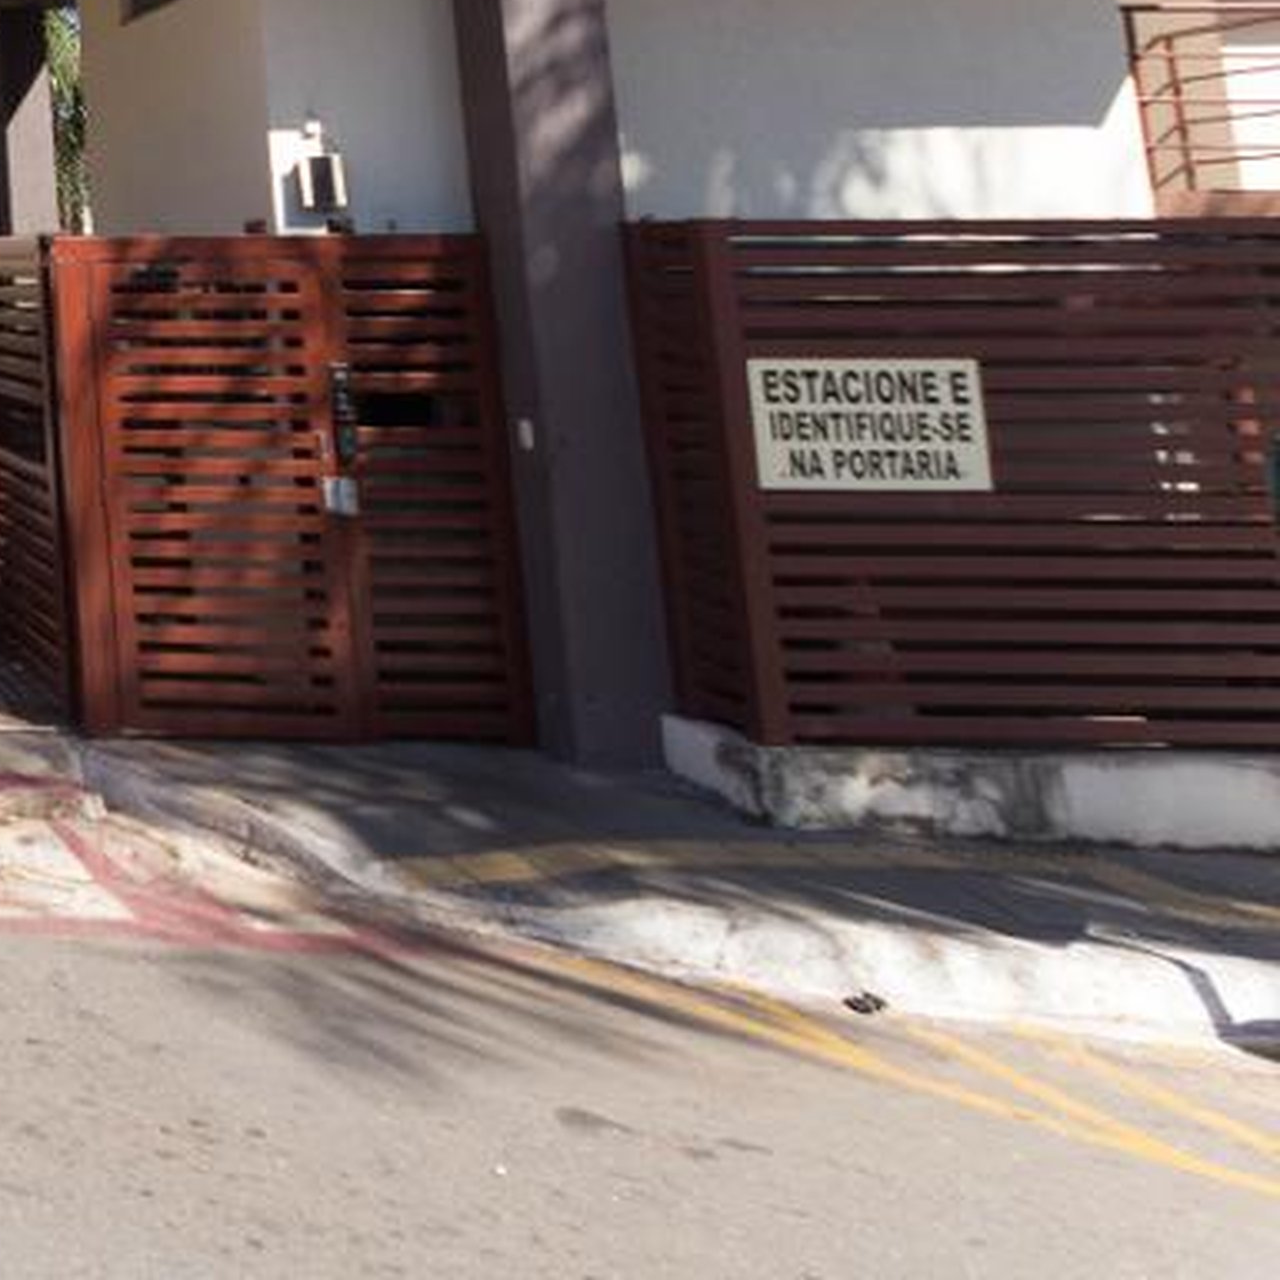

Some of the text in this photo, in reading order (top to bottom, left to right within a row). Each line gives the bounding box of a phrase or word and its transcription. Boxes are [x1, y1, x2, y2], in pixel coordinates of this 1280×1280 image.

[761, 370, 971, 404] ESTACIONE E
[770, 411, 972, 442] IDENTIFIQUE-SE
[790, 449, 961, 480] NA PORTARIA
